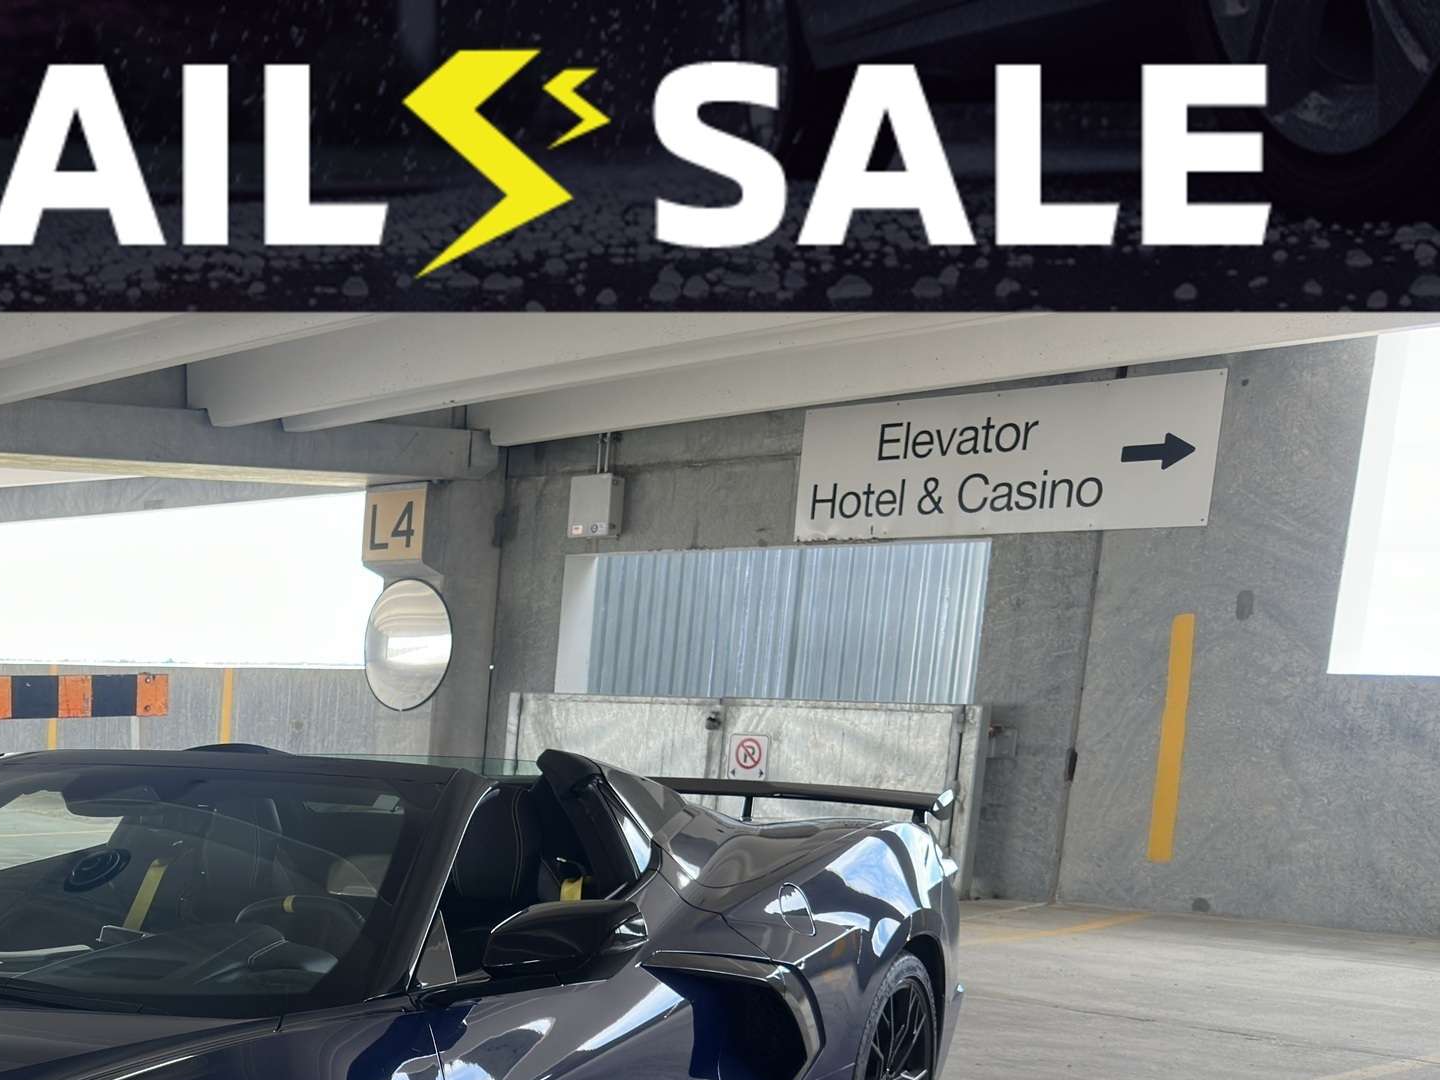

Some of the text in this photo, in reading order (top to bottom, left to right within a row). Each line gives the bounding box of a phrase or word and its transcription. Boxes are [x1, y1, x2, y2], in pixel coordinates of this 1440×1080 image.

[877, 416, 1040, 462] Elevator
[810, 469, 1104, 521] Hotel & Casino
[370, 500, 415, 550] L4
